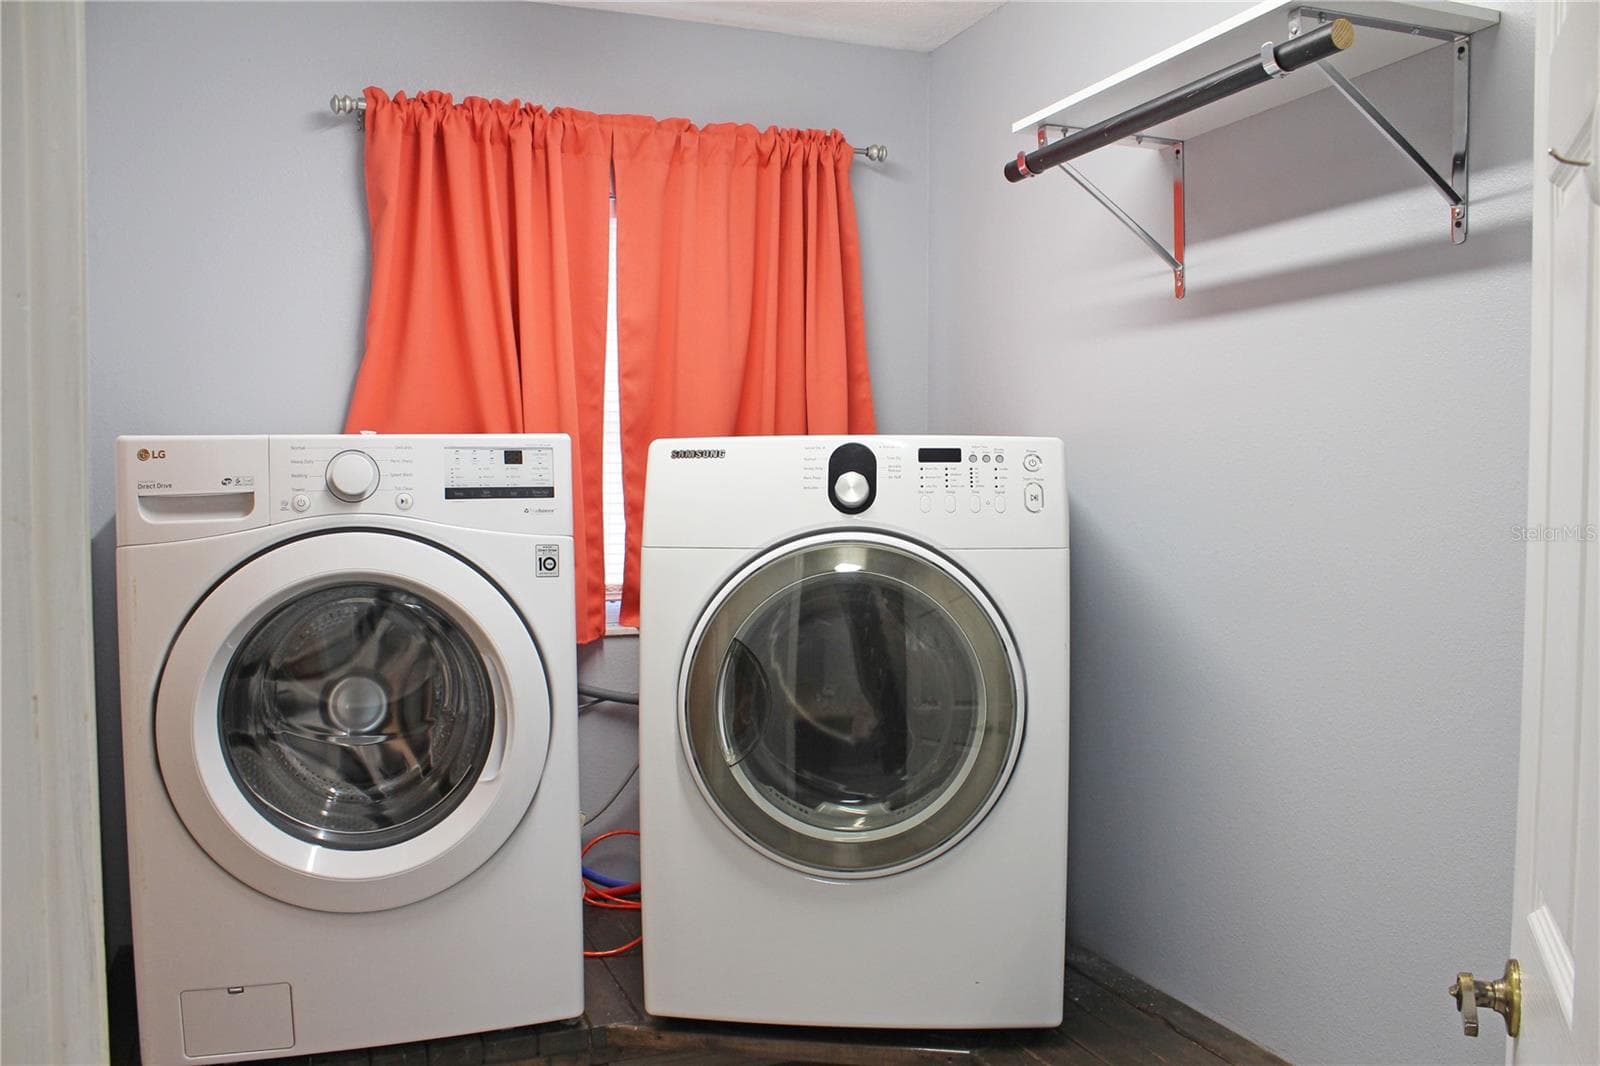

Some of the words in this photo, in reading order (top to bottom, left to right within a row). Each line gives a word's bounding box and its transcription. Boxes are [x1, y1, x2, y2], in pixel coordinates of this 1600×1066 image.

[151, 450, 166, 459] LG
[671, 450, 726, 459] SAMSUNG
[538, 556, 557, 571] 10
